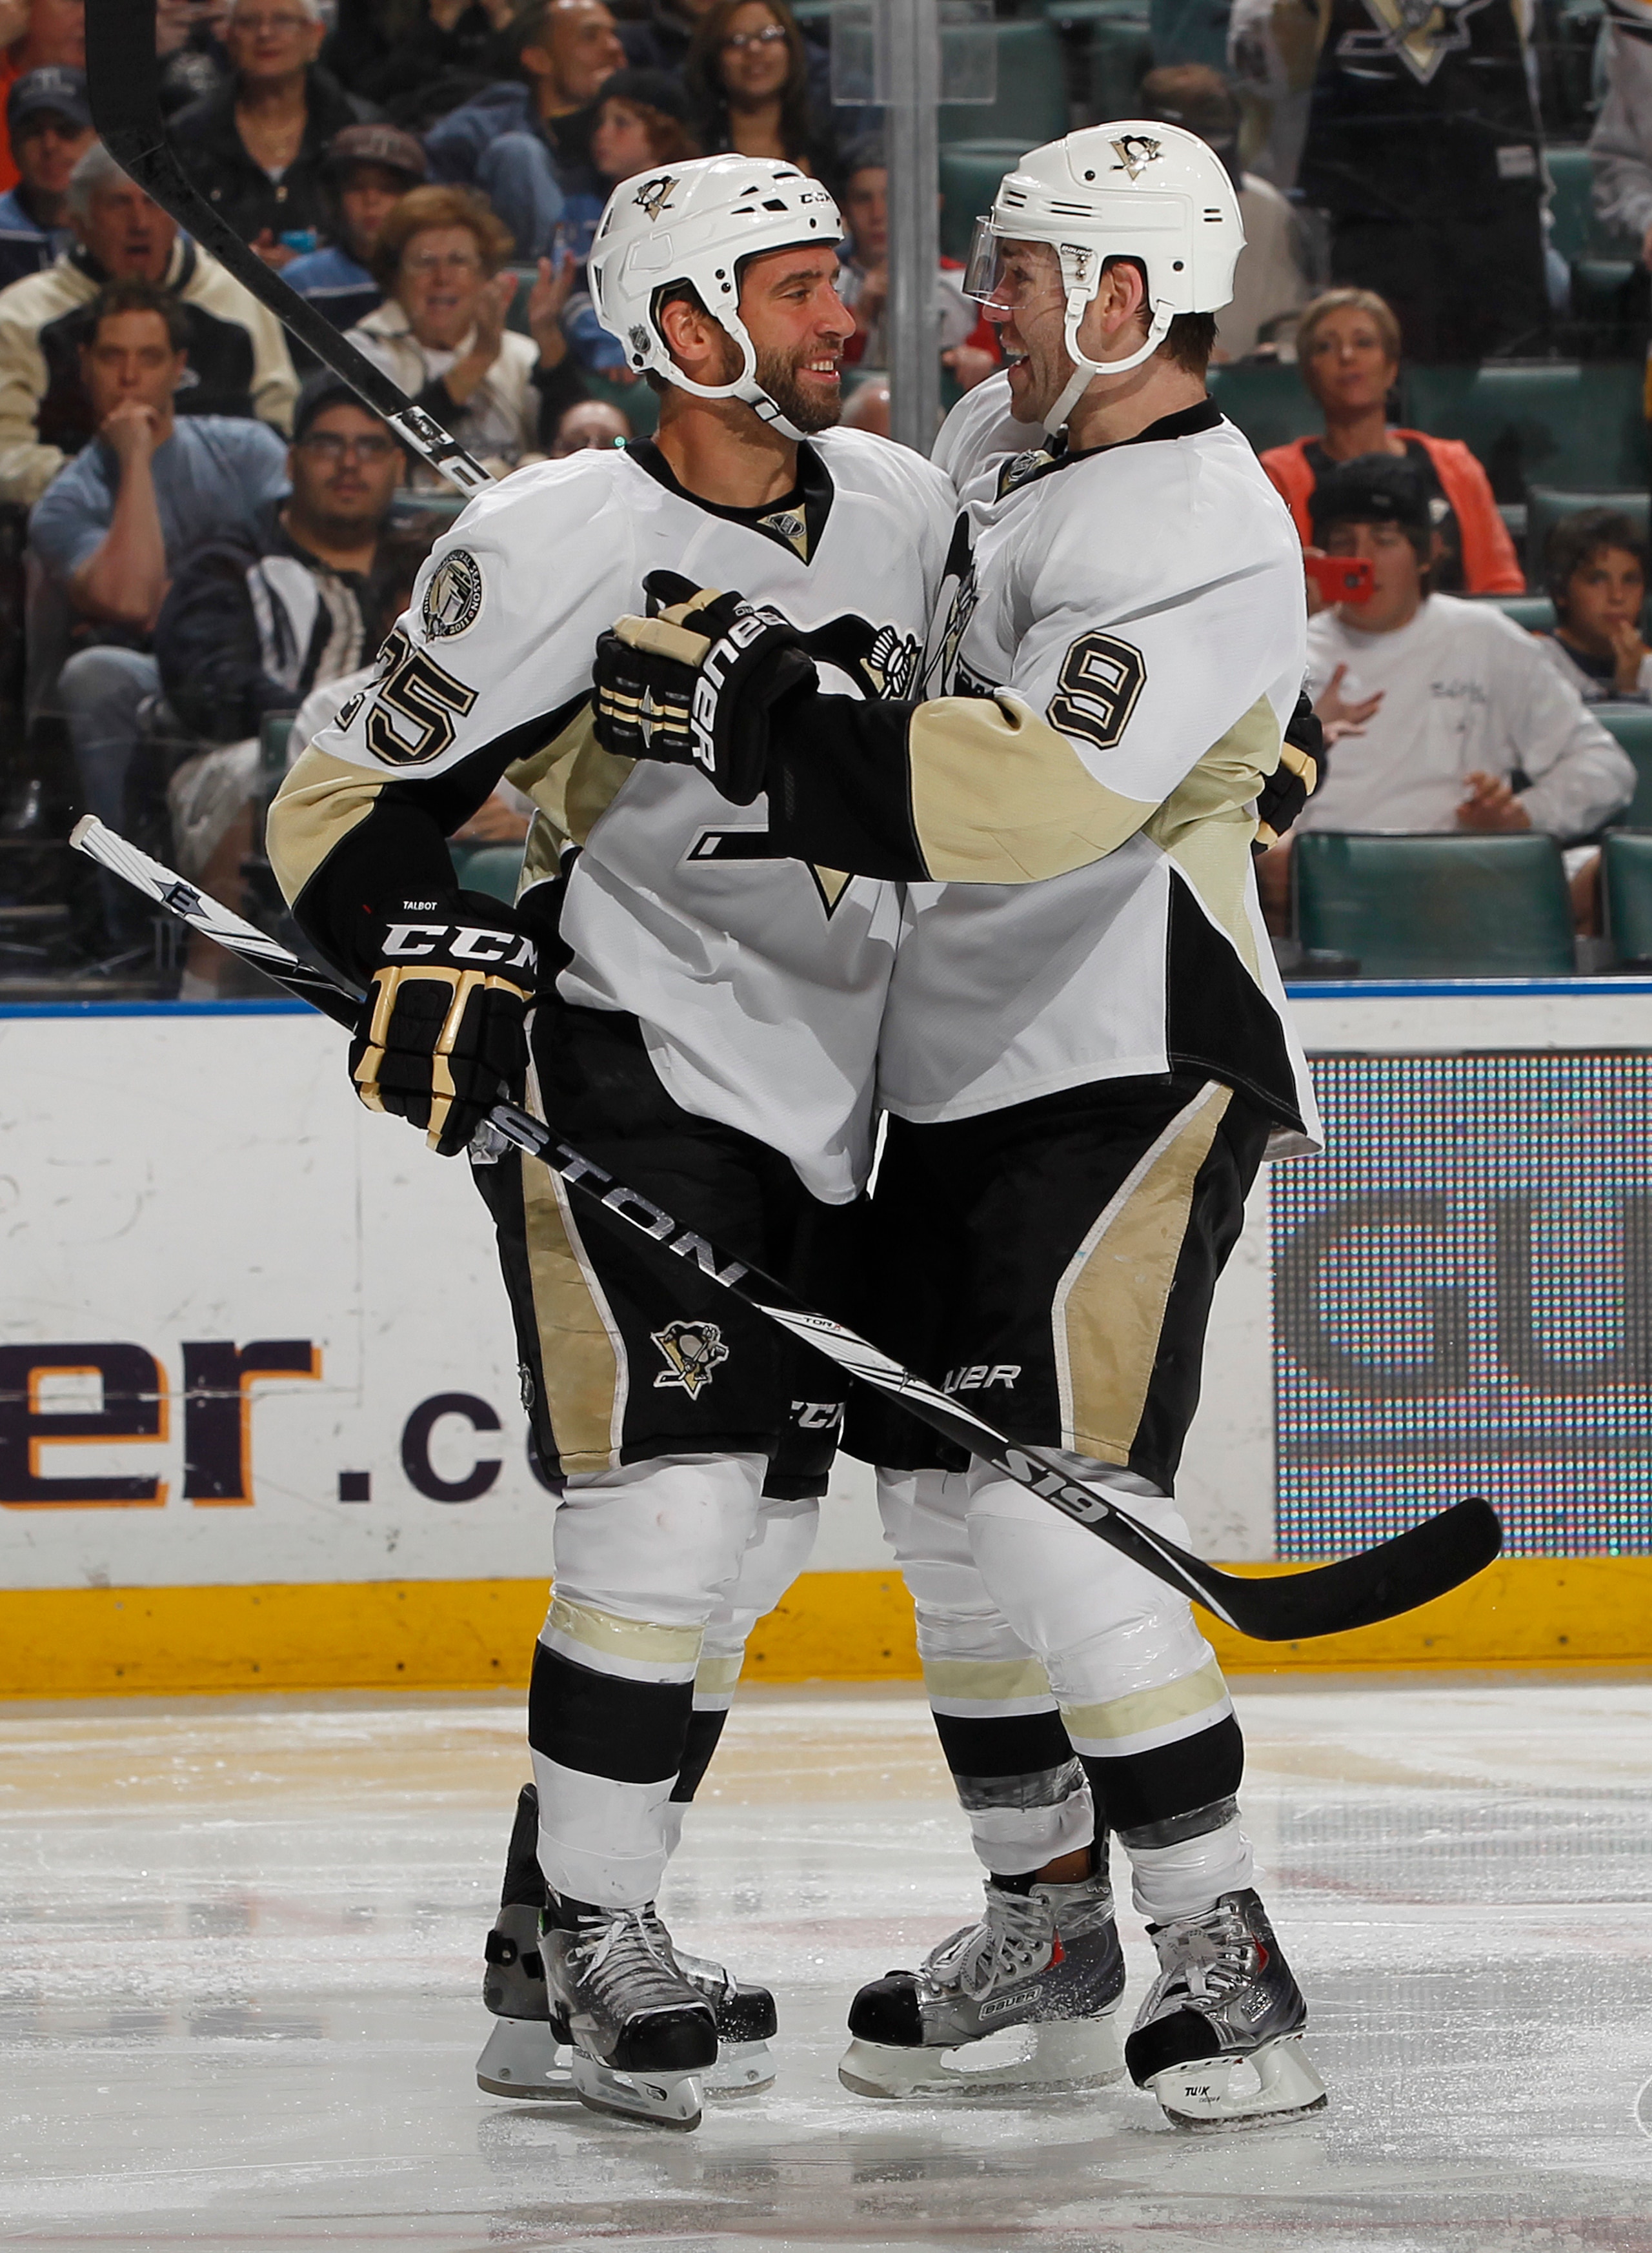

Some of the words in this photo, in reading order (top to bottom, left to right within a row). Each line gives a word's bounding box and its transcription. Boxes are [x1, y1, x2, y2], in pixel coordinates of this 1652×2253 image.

[449, 618, 470, 634] 2011
[1045, 631, 1147, 751] 9
[403, 901, 437, 911] TALBOT
[991, 1449, 1109, 1523] S19
